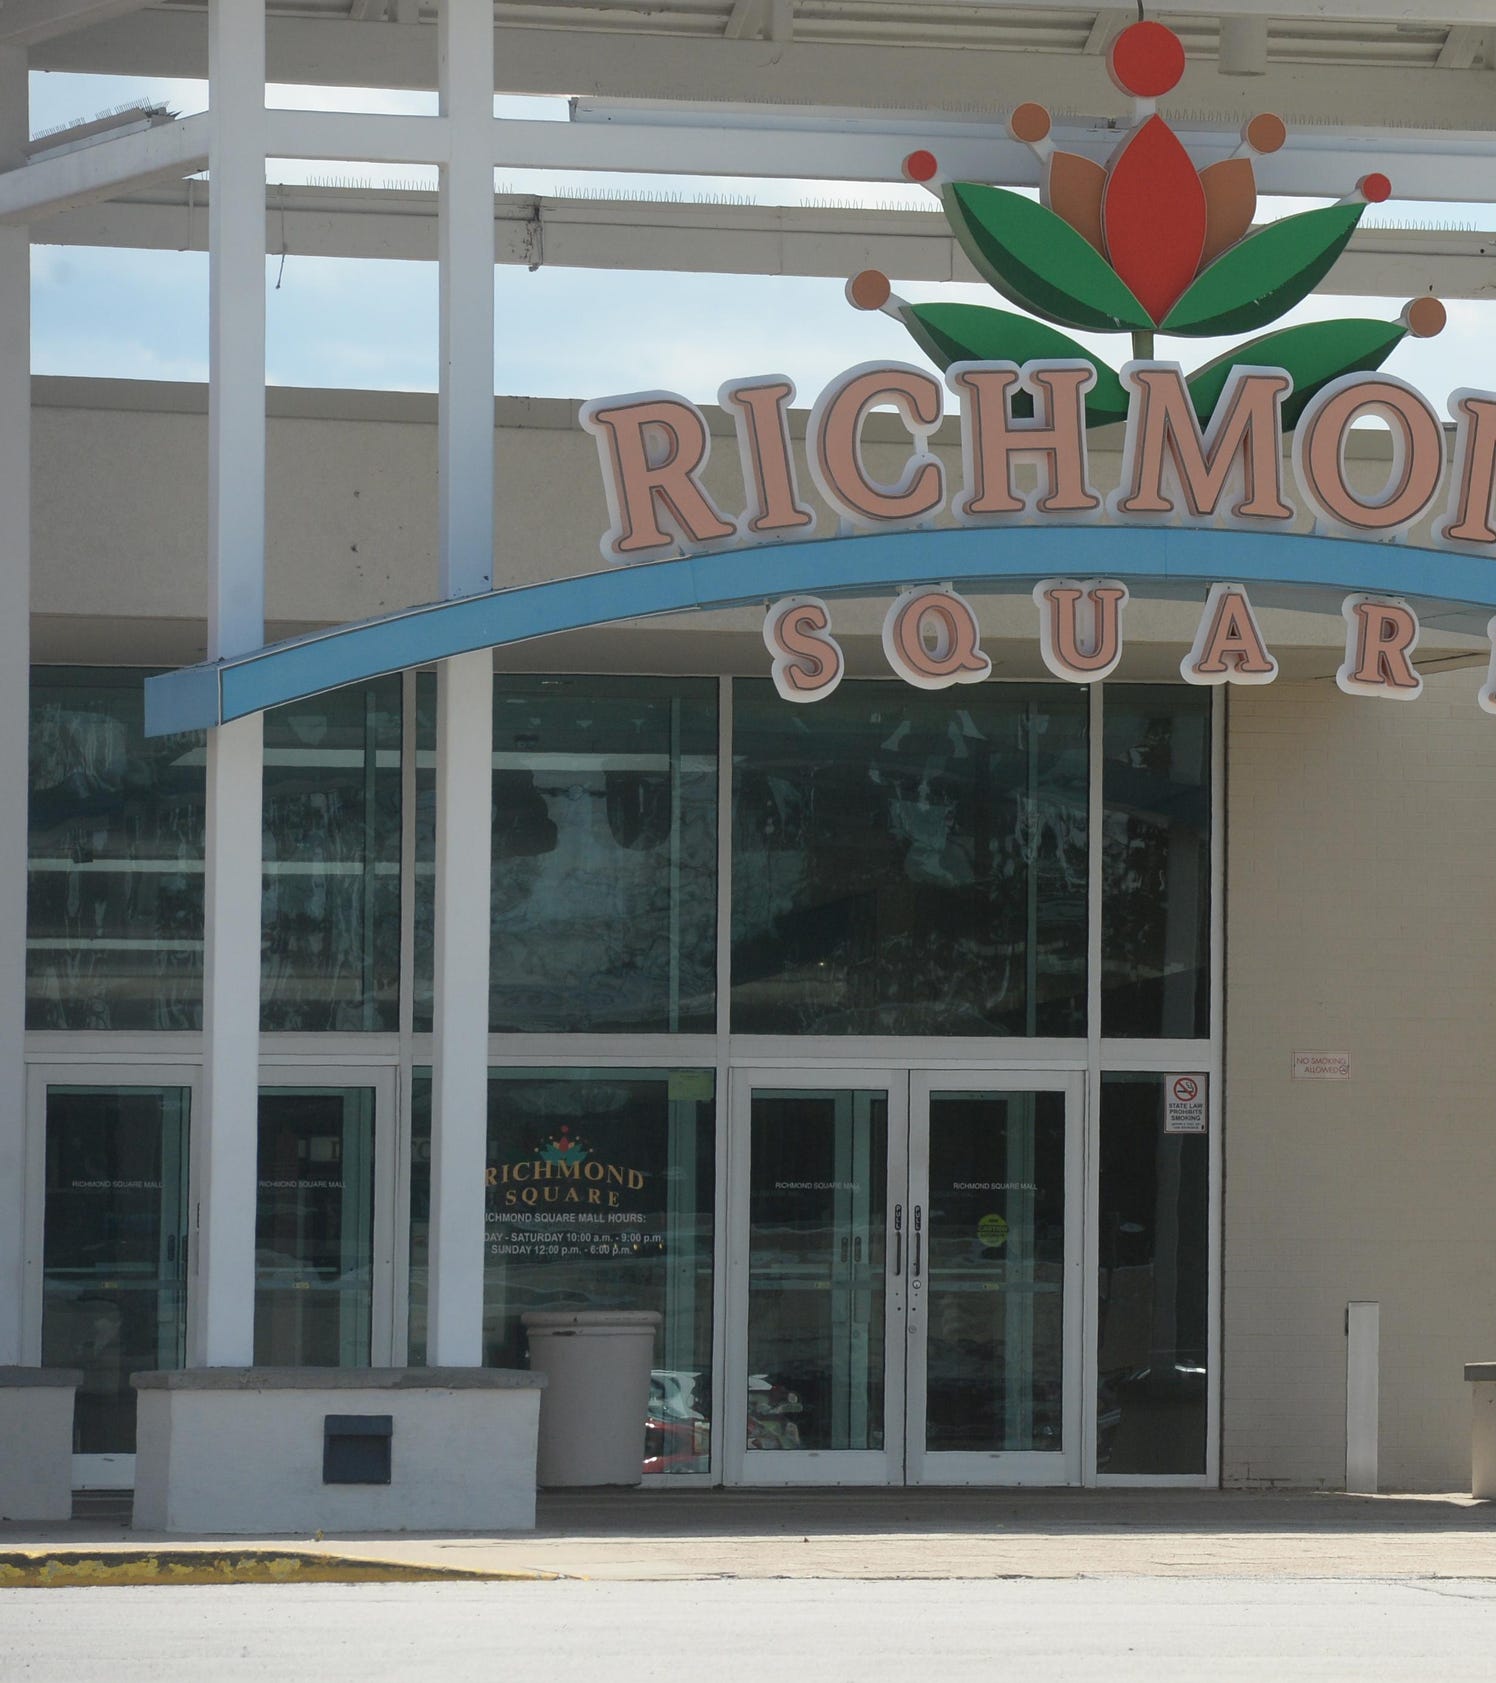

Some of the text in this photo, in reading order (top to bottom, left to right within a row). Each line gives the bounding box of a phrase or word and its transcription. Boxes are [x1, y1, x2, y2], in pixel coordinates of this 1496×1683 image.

[1296, 1057, 1346, 1065] NO SMOKING
[485, 1160, 644, 1190] RICHMOND
[505, 1187, 619, 1208] SQUARE
[485, 1213, 647, 1223] ICHMOND SQUARE MALL HOURS:
[511, 1232, 564, 1242] SATURDAY
[567, 1232, 591, 1242] 10:00
[593, 1233, 613, 1242] a.m.
[621, 1232, 641, 1242] 9:00
[643, 1234, 664, 1244] p.m.
[491, 1244, 532, 1254] SUNDAY
[534, 1245, 559, 1254] 12:00
[561, 1247, 581, 1256] p.m.
[590, 1245, 610, 1254] 6:00
[612, 1247, 633, 1256] p.m.
